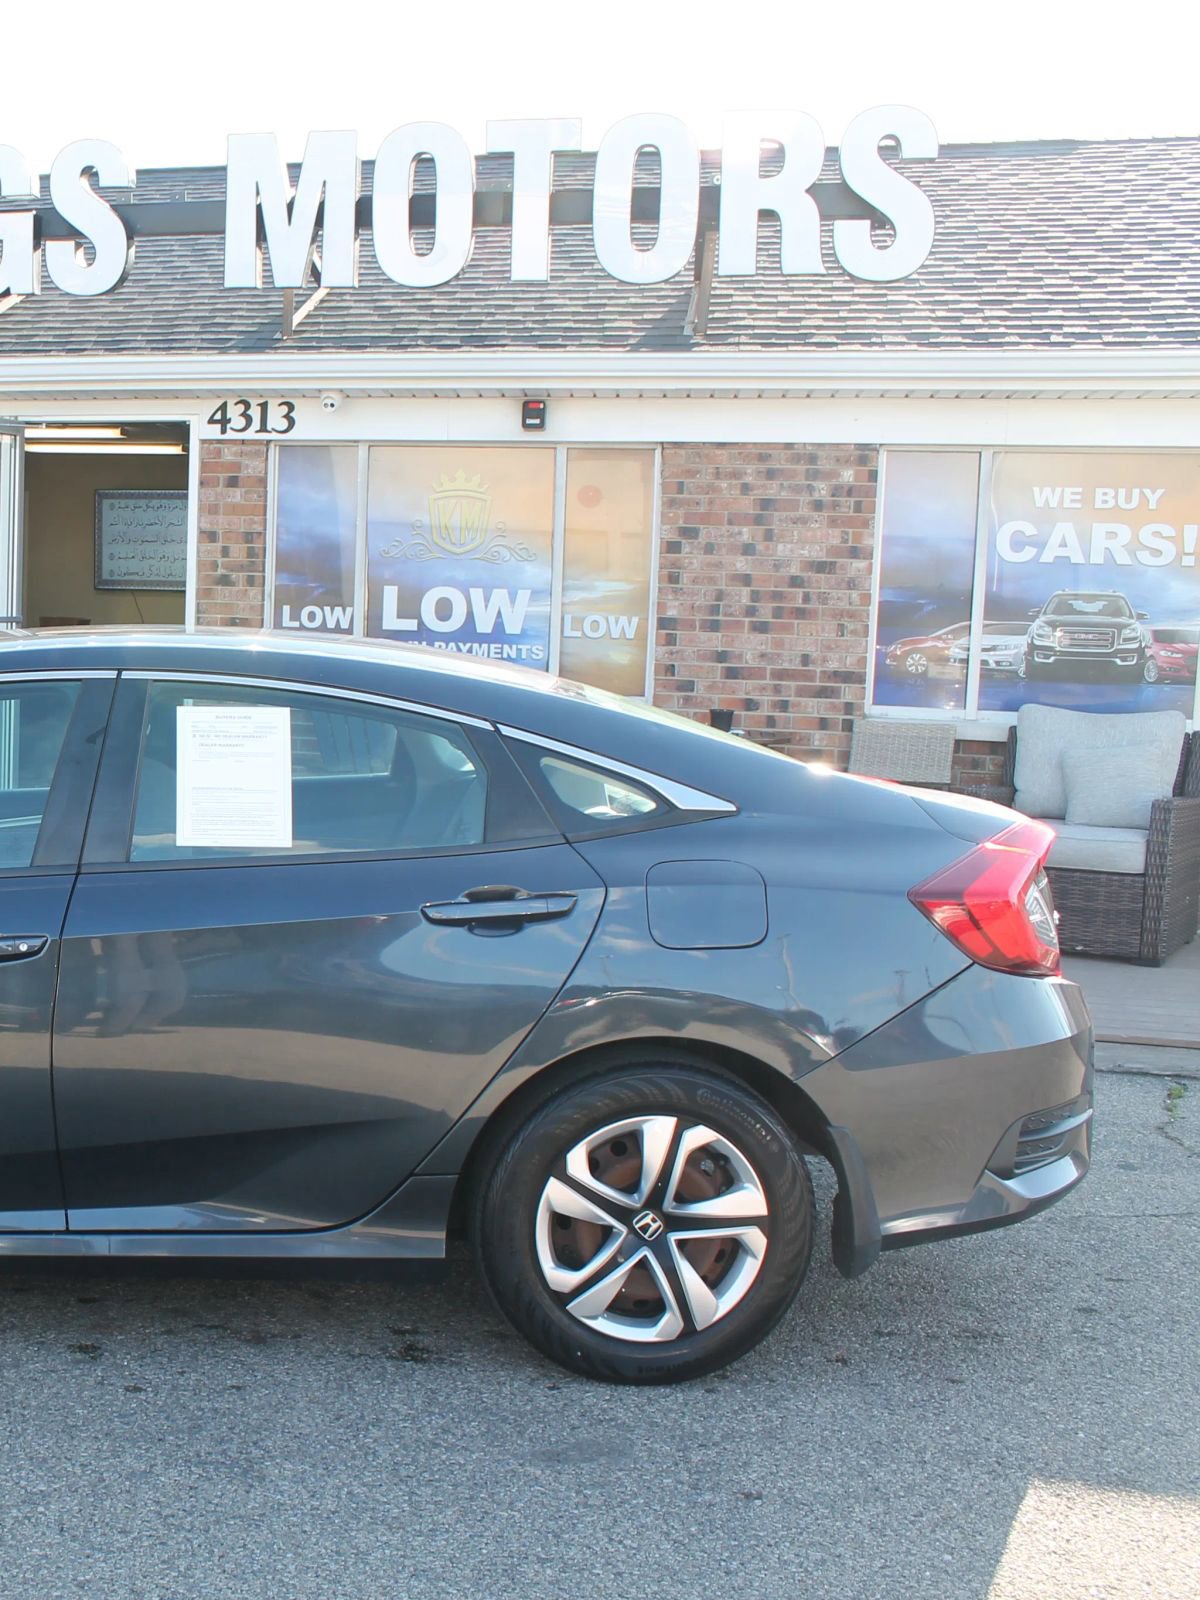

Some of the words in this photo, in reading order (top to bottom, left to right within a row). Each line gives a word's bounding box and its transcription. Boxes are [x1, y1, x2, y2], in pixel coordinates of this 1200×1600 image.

[223, 104, 940, 288] MOTORS
[207, 399, 295, 435] 4313
[1032, 486, 1083, 509] WE
[1094, 487, 1166, 510] BUY
[437, 500, 482, 545] KM
[995, 520, 1198, 567] CARS!
[281, 605, 353, 630] LOW
[381, 585, 531, 635] LOW
[563, 614, 639, 640] LOW
